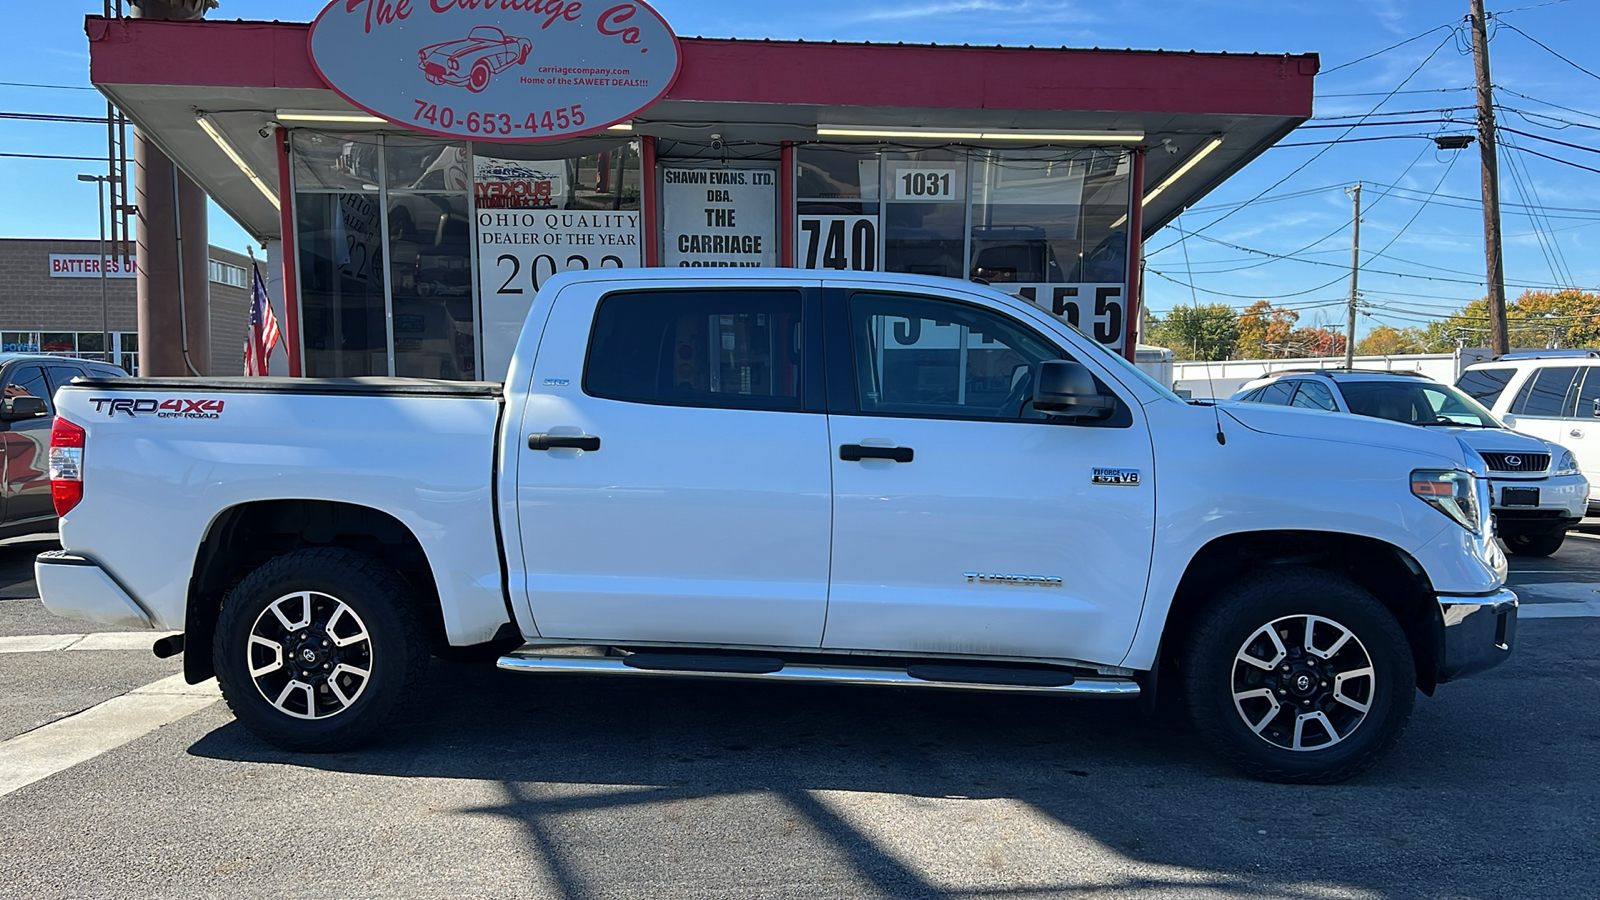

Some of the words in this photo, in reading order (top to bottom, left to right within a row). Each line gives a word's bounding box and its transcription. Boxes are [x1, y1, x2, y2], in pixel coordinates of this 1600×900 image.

[596, 3, 648, 53] Co.
[538, 66, 630, 76] carriagecompany.com
[520, 76, 545, 84] Home
[558, 77, 572, 85] the
[573, 78, 610, 86] SAWEET
[612, 79, 648, 87] DEALS!!!
[413, 99, 586, 134] 740-653-4455
[665, 171, 707, 184] SHAWN
[709, 172, 748, 185] EVANS.
[752, 173, 774, 186] LTD.
[902, 172, 949, 195] 1031
[707, 190, 733, 202] DBA.
[479, 213, 535, 227] OHIO
[545, 213, 638, 230] QUALITY
[704, 208, 736, 227] THE
[482, 232, 540, 245] DEALER
[543, 233, 562, 245] OF
[566, 234, 595, 245] THE
[599, 234, 636, 246] YEAR
[678, 234, 762, 253] CARRIAGE
[801, 218, 875, 271] 740
[53, 259, 119, 273] BATTERES
[88, 398, 160, 417] TRD
[1121, 473, 1138, 482] V8
[962, 572, 1062, 587] TUNDRA
